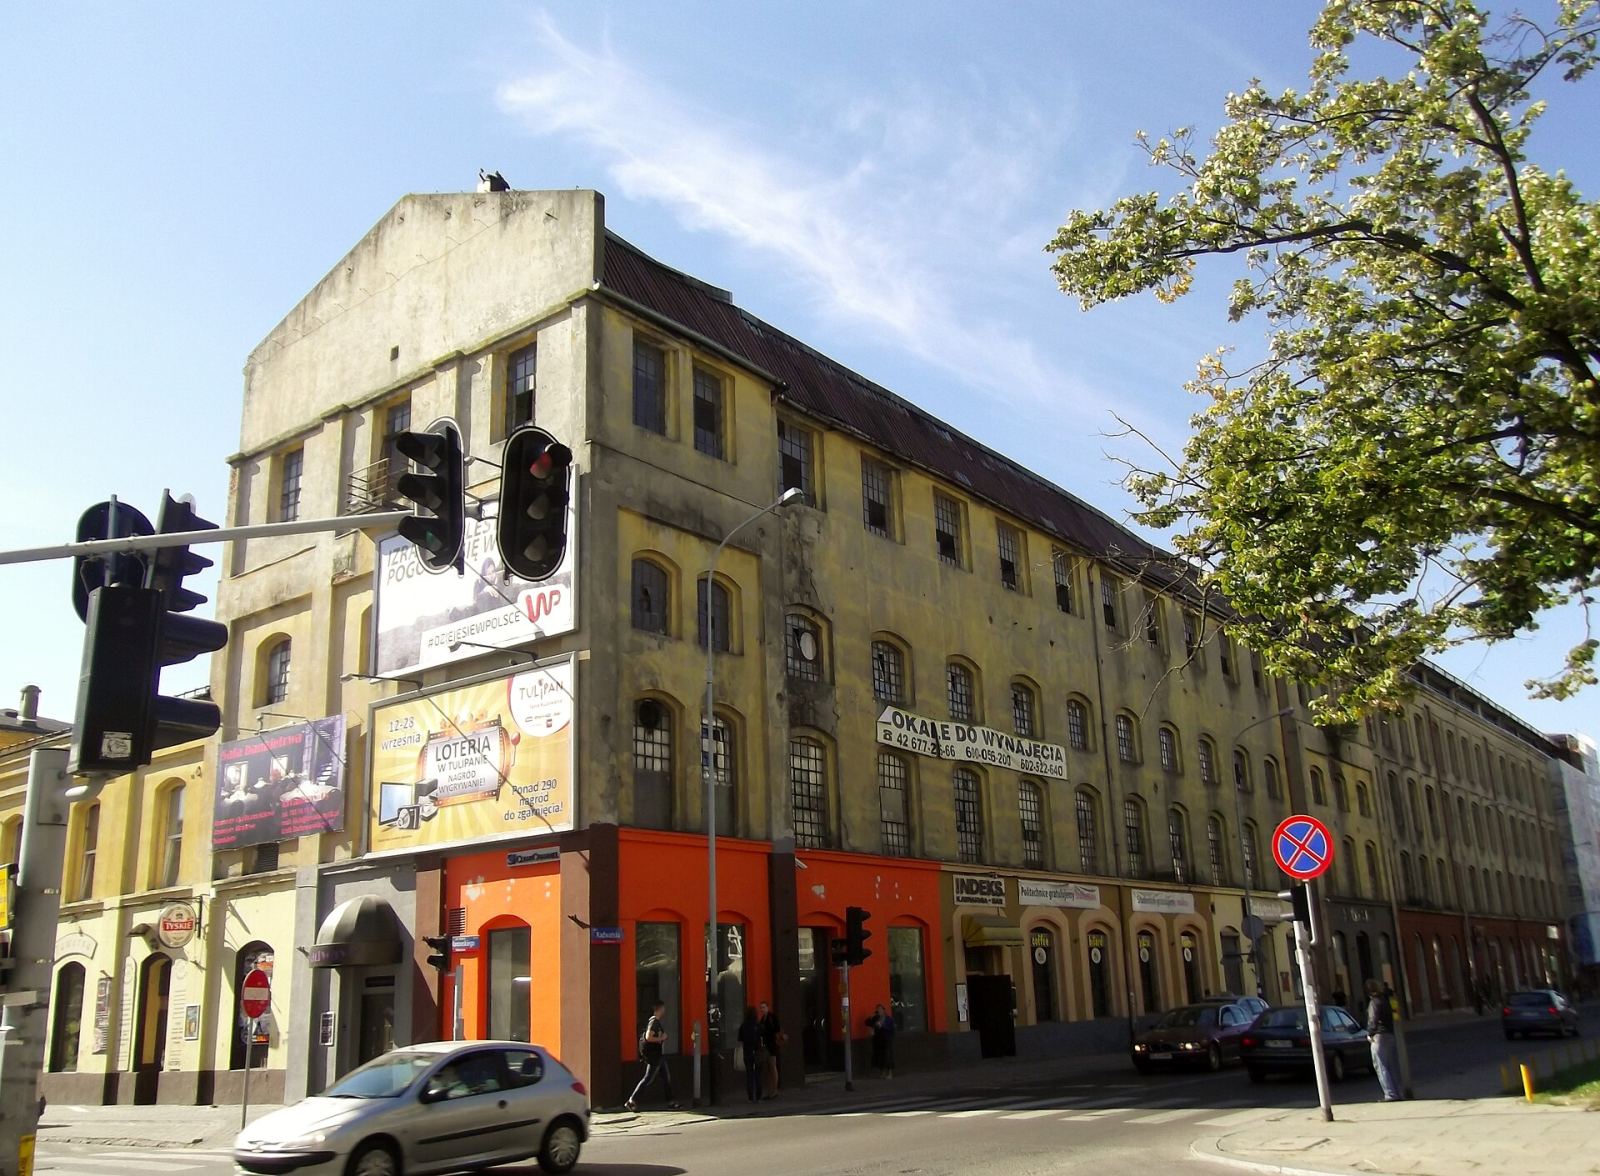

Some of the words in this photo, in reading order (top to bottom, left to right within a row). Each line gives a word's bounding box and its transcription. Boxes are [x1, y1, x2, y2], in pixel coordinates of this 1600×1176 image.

[897, 733, 909, 747] 42
[955, 725, 978, 743] DO
[981, 729, 1064, 763] WYNAJĘCIA
[435, 735, 491, 762] LOTERIA
[437, 760, 447, 773] W
[448, 754, 488, 771] TULIPANIE
[438, 778, 486, 794] WYGRYWANIE!
[512, 781, 539, 796] Ponad
[540, 779, 557, 792] 290
[504, 810, 515, 821] do
[164, 921, 192, 931] TYSKIE
